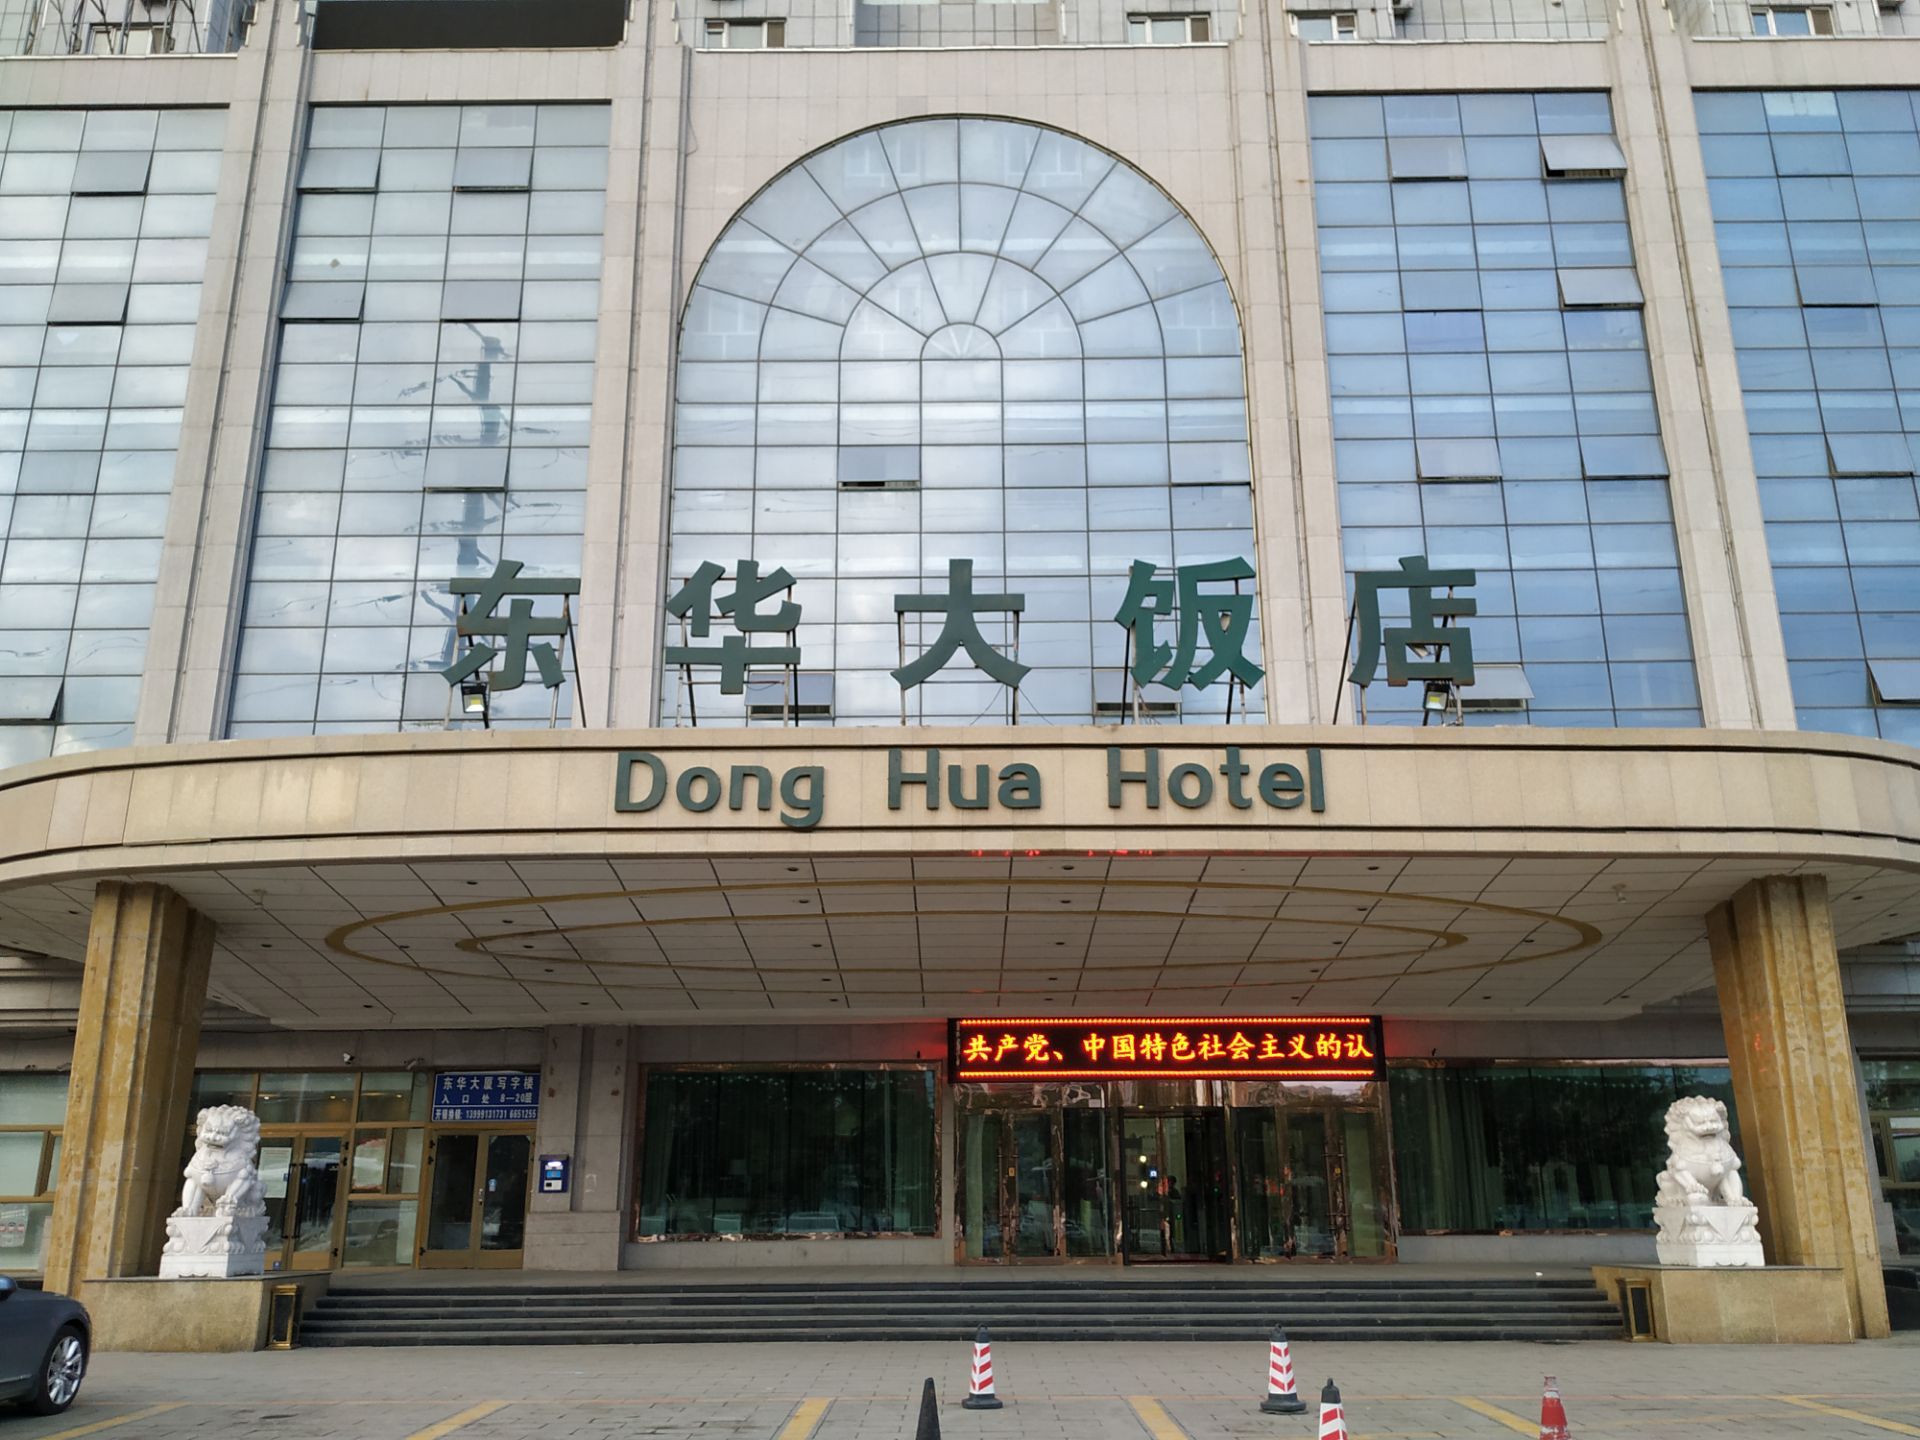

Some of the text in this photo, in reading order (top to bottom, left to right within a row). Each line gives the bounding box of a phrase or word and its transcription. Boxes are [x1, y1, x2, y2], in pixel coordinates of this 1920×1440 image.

[442, 556, 1477, 695] 东华大饭店
[614, 746, 1326, 832] Dong Hua Hotel
[443, 1076, 534, 1091] 东华大厦写字楼
